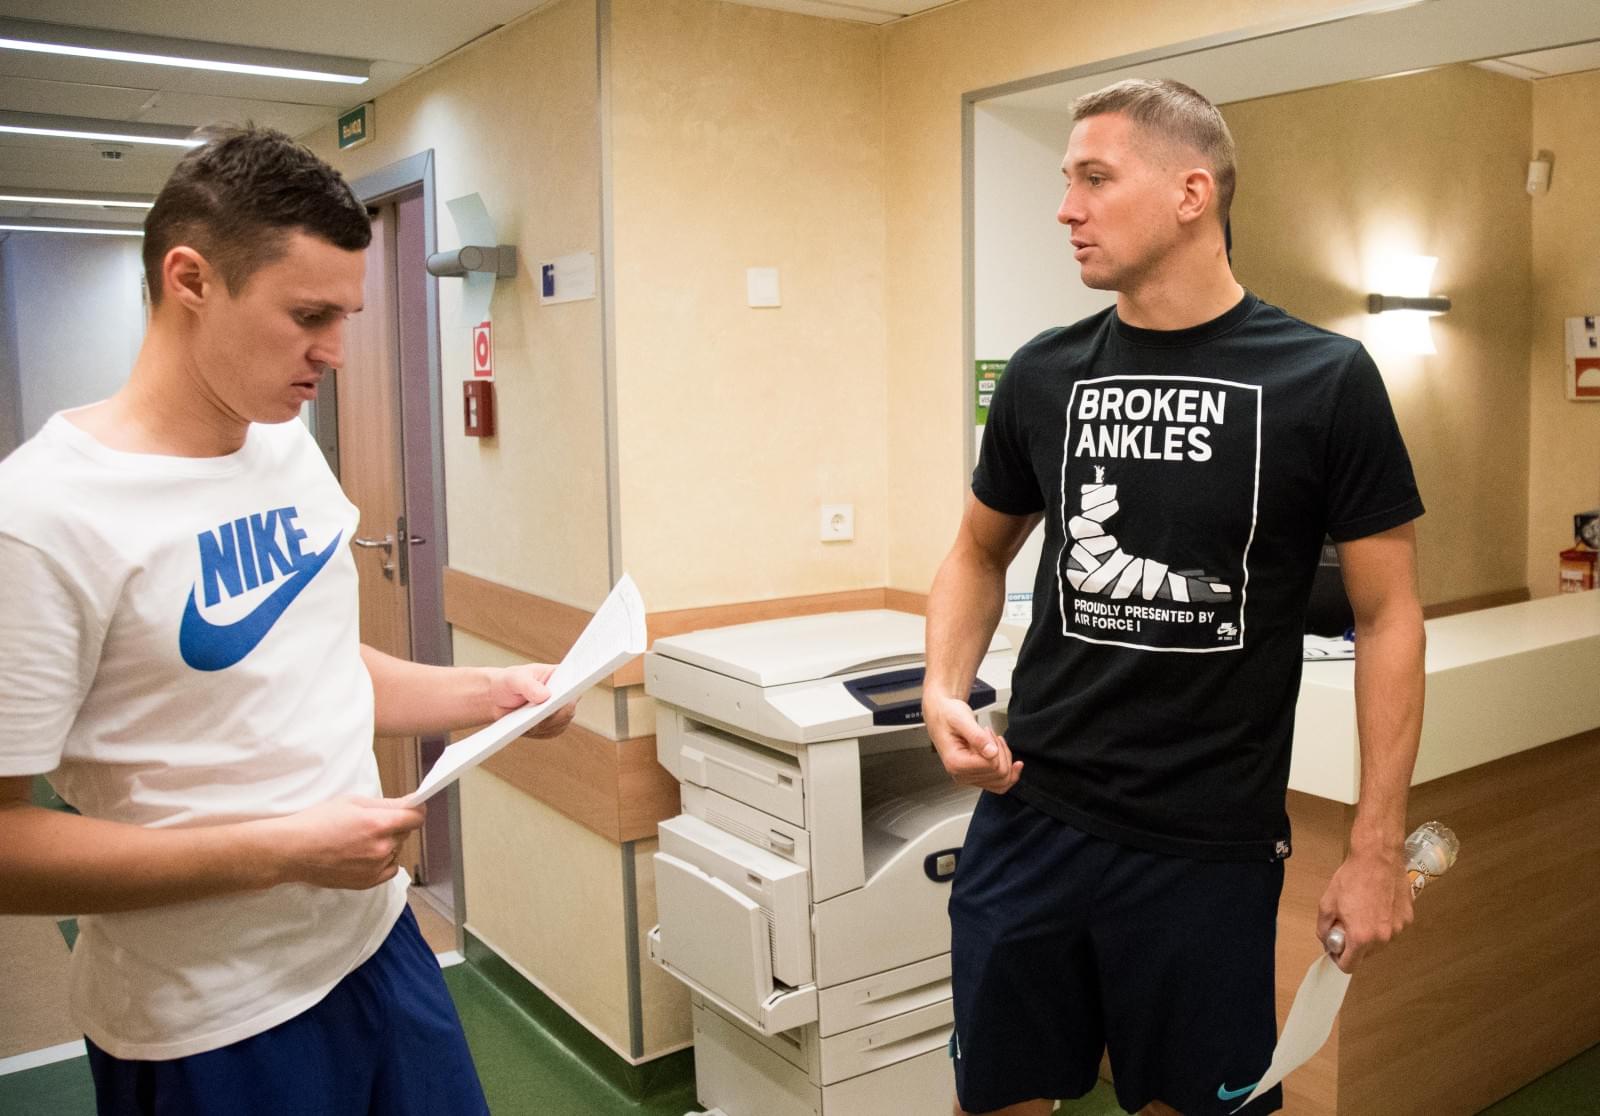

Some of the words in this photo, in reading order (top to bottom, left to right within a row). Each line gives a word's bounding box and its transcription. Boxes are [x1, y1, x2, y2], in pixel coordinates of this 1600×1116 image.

[1078, 387, 1227, 425] BROKEN
[1074, 423, 1212, 462] ANKLES
[197, 506, 318, 608] NIKE
[1074, 599, 1121, 617] PROUDLY
[1125, 606, 1194, 623] PRESENTED
[1199, 611, 1215, 623] BY
[1074, 612, 1090, 626] AIR
[1092, 616, 1133, 631] FORCE
